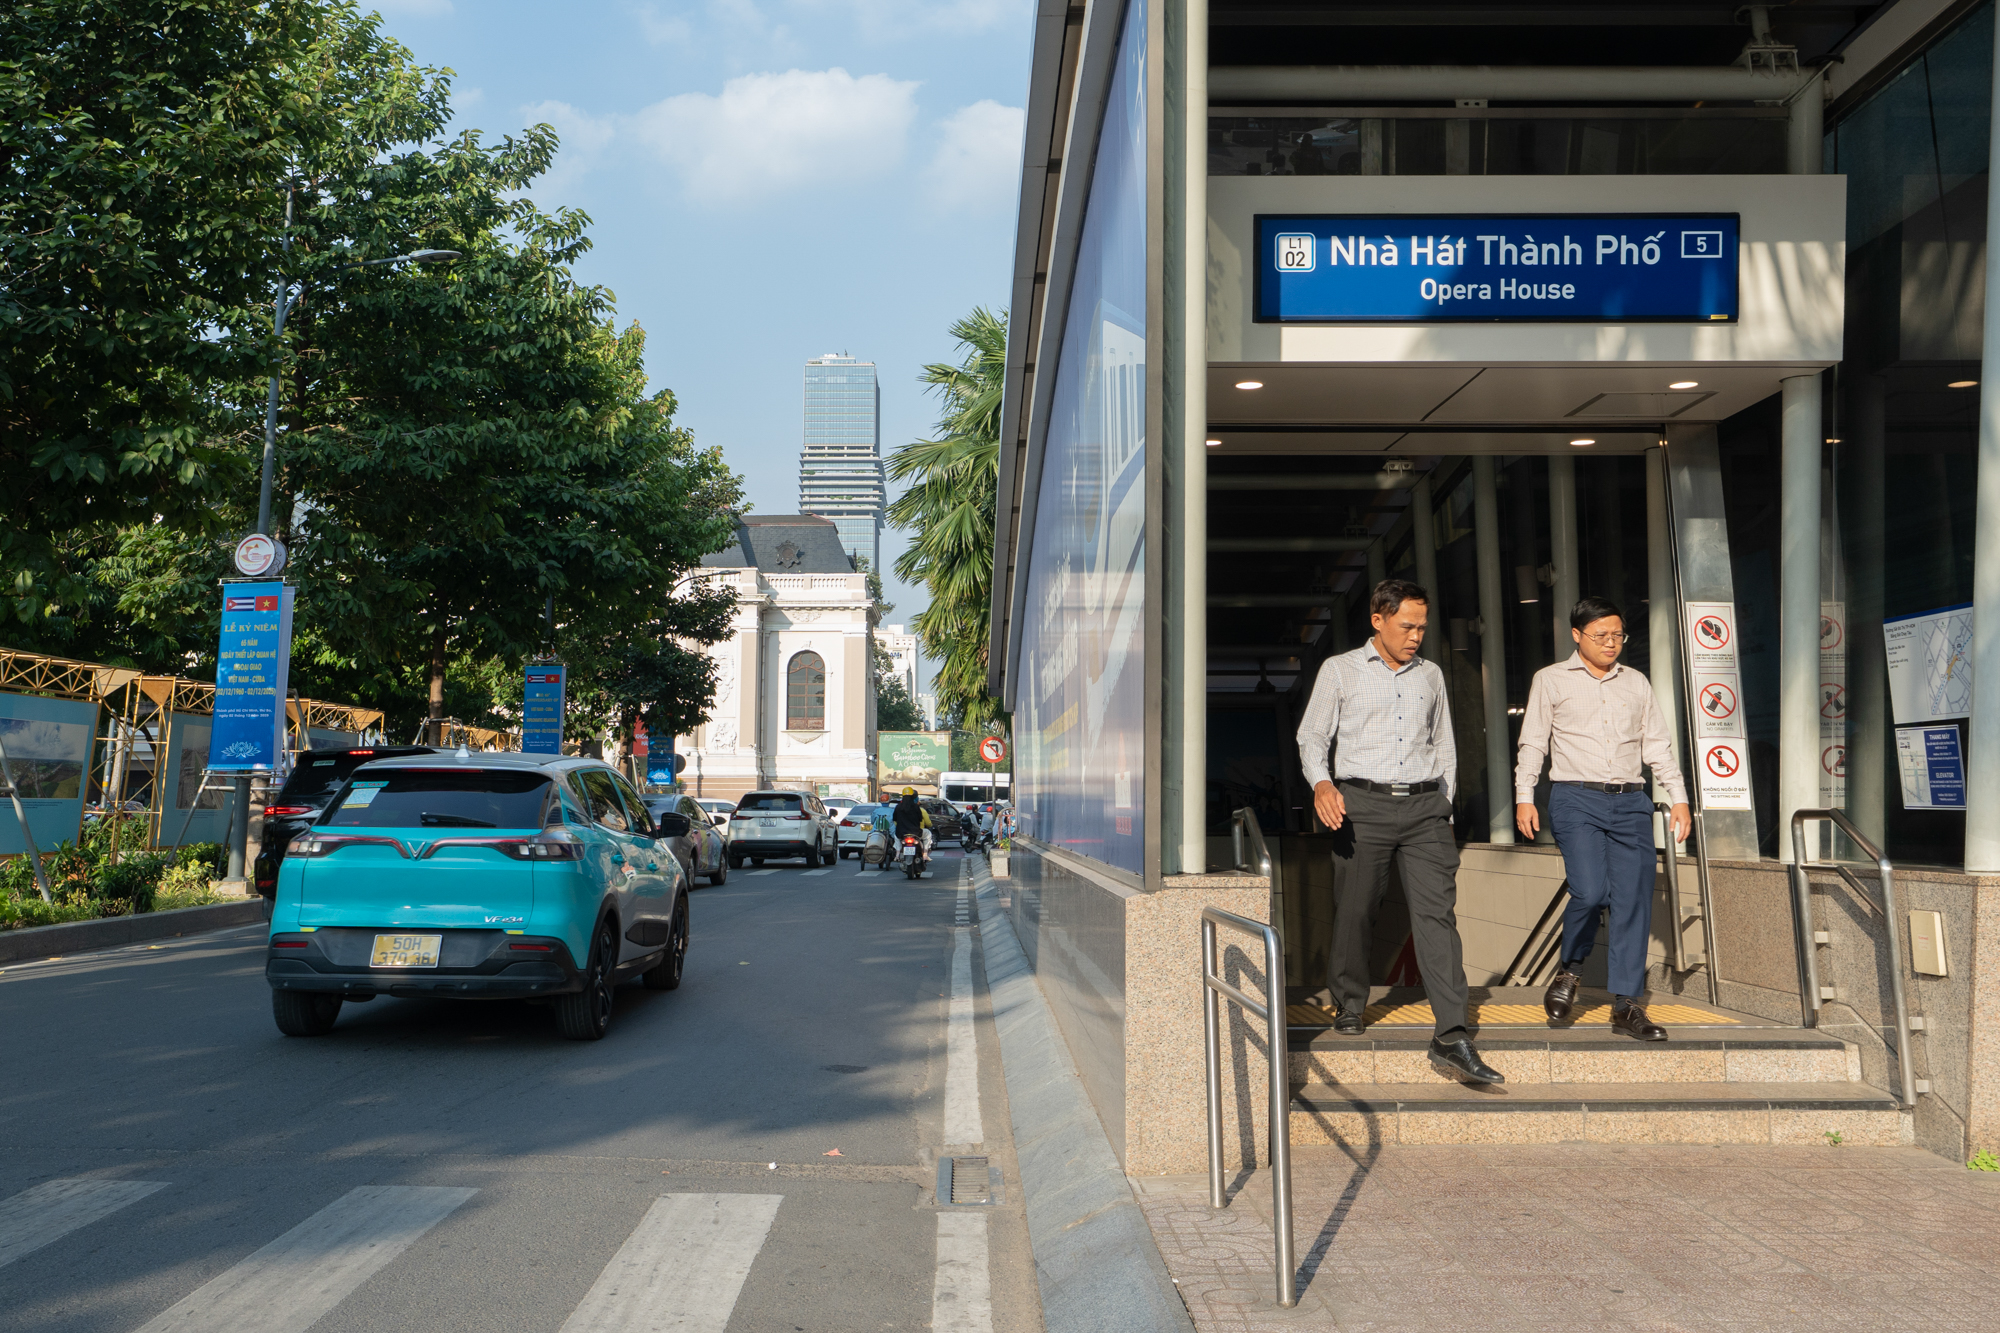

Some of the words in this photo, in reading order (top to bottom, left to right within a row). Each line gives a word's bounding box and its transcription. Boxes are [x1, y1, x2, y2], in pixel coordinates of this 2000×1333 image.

[1289, 238, 1302, 249] L1
[1331, 235, 1398, 266] Nhà
[1411, 235, 1467, 266] Hát
[1476, 234, 1582, 265] Thành
[1596, 231, 1666, 265] Phố
[1697, 236, 1707, 253] 5
[1285, 251, 1306, 267] 02
[1420, 278, 1492, 305] Opera
[1500, 278, 1575, 299] House
[224, 621, 236, 632] LỄ
[254, 623, 278, 632] NIỆM
[393, 937, 422, 950] 50H
